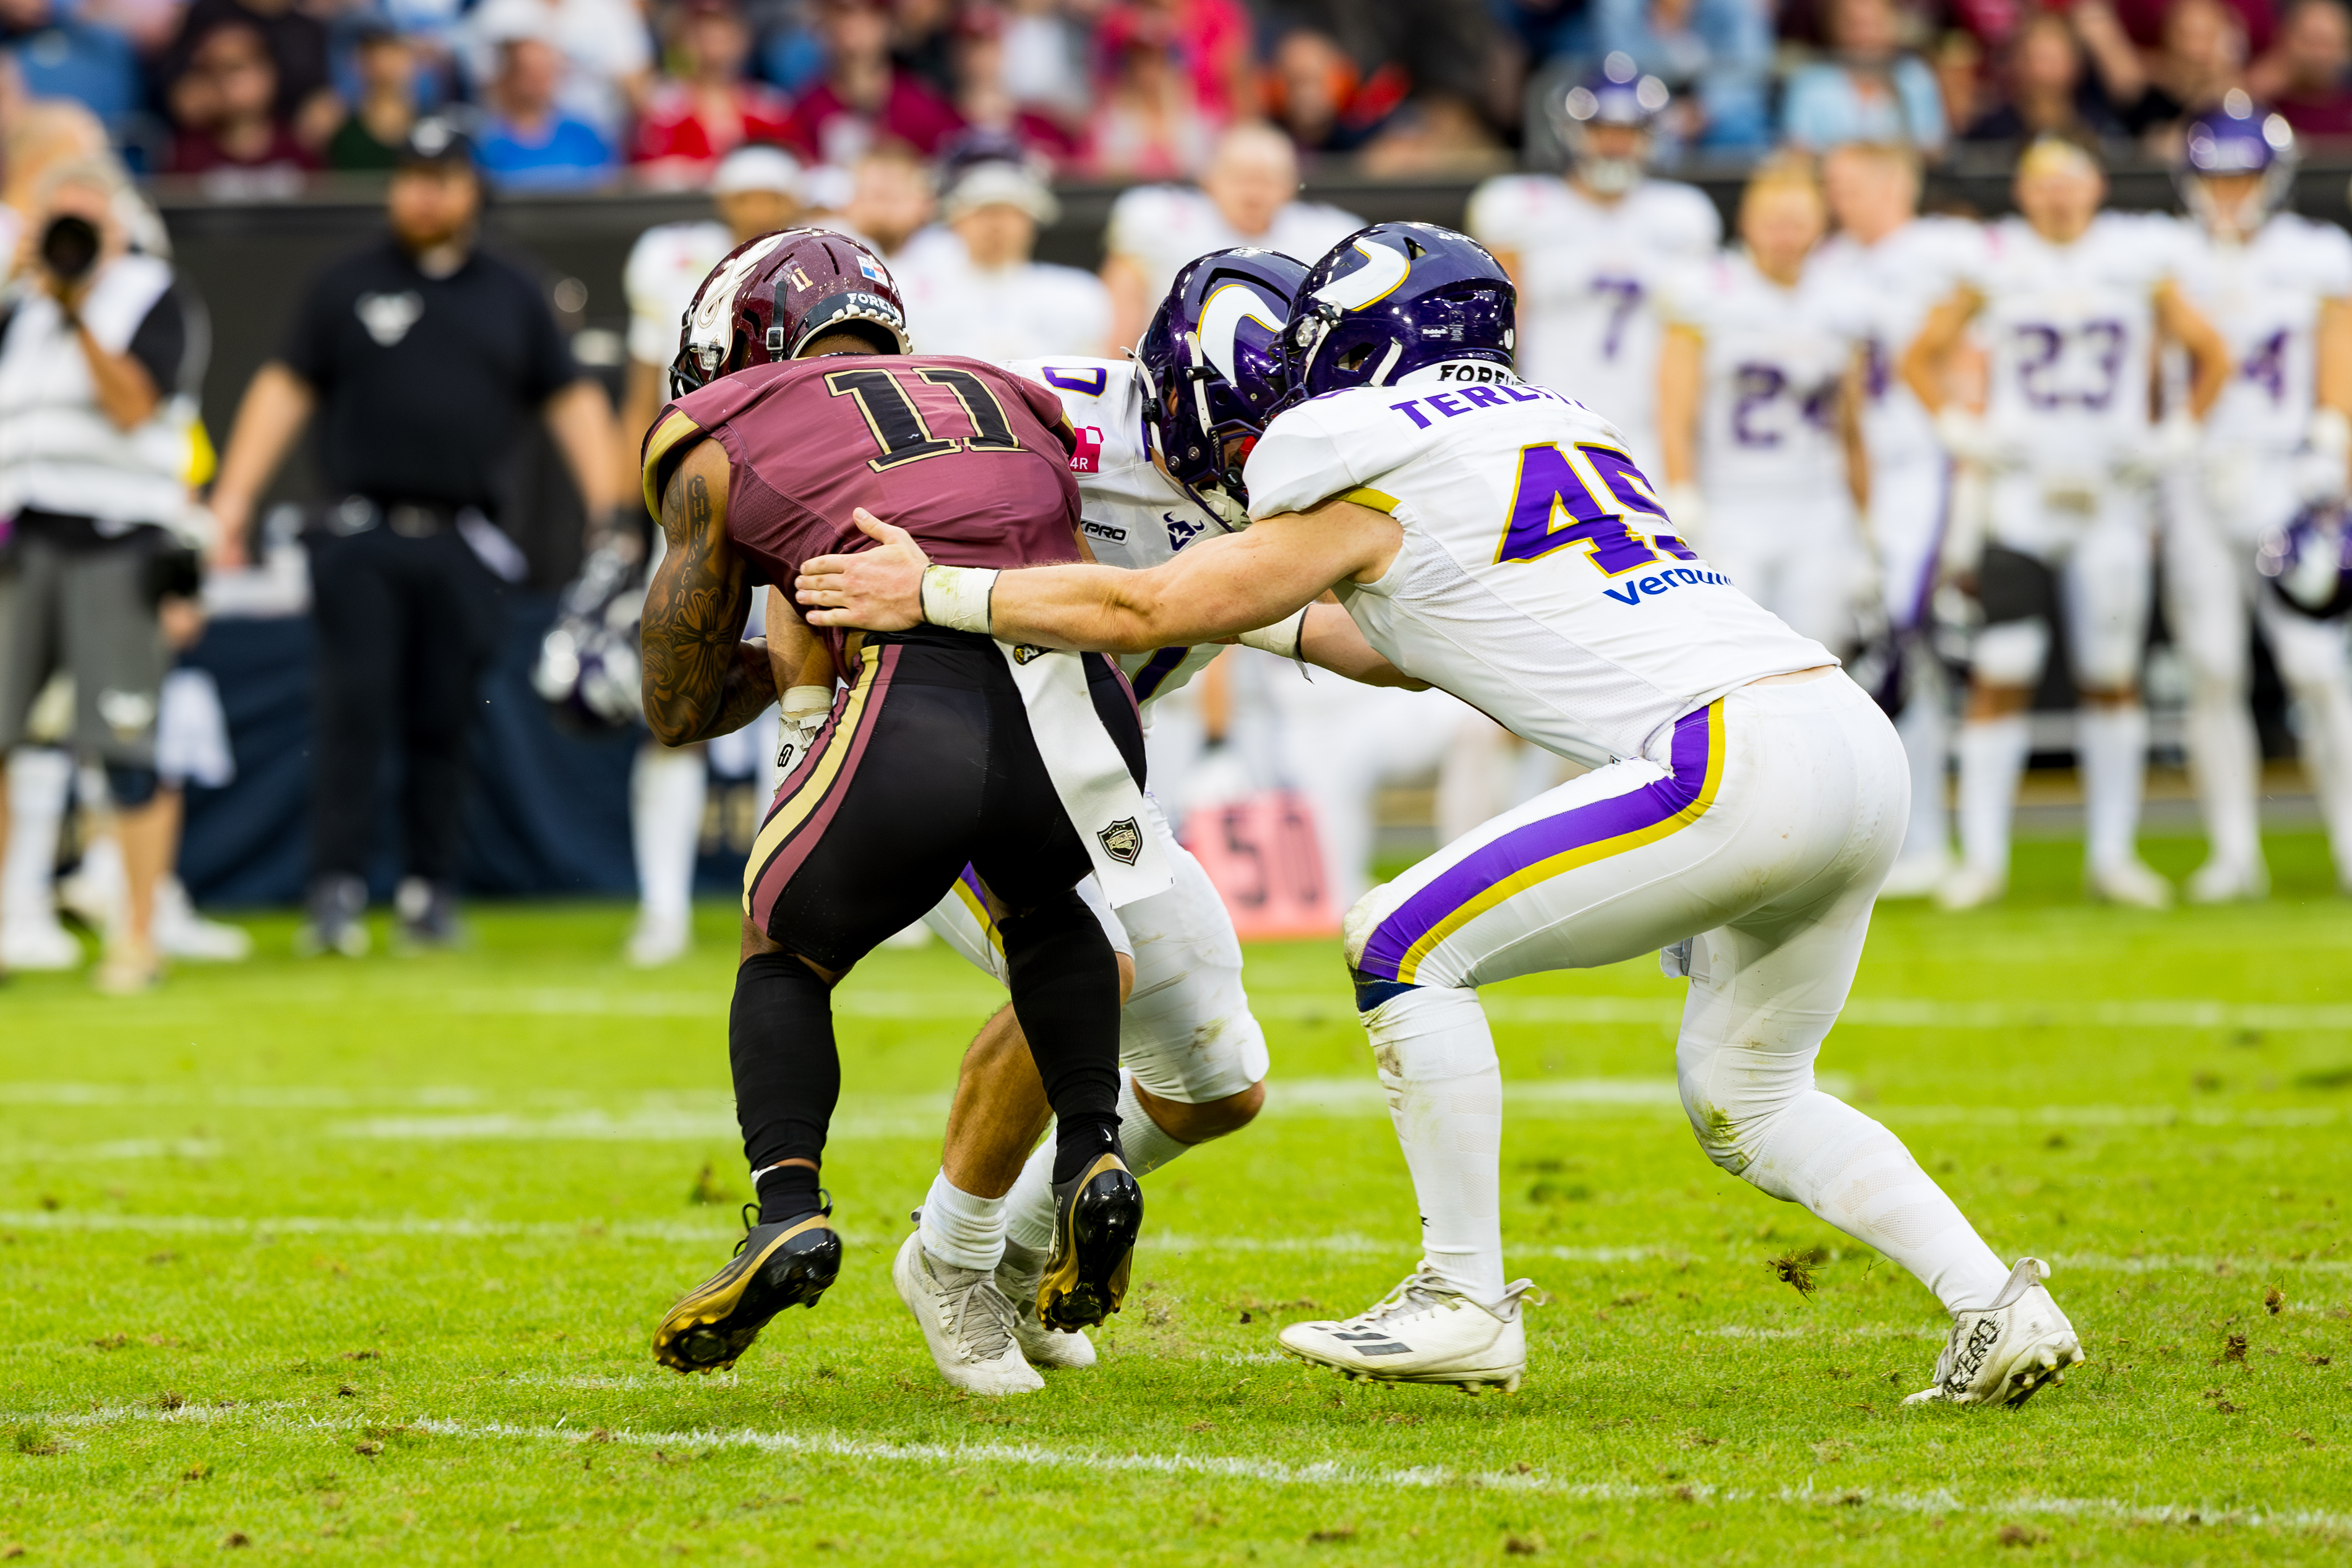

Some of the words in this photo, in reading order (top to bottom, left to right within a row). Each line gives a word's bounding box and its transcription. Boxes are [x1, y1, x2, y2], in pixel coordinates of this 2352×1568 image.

[787, 267, 814, 293] 11
[2013, 319, 2126, 411] 23
[824, 366, 1033, 474] 11
[1070, 456, 1089, 470] 4R
[1080, 520, 1127, 541] PRO
[1491, 441, 1699, 579] 45
